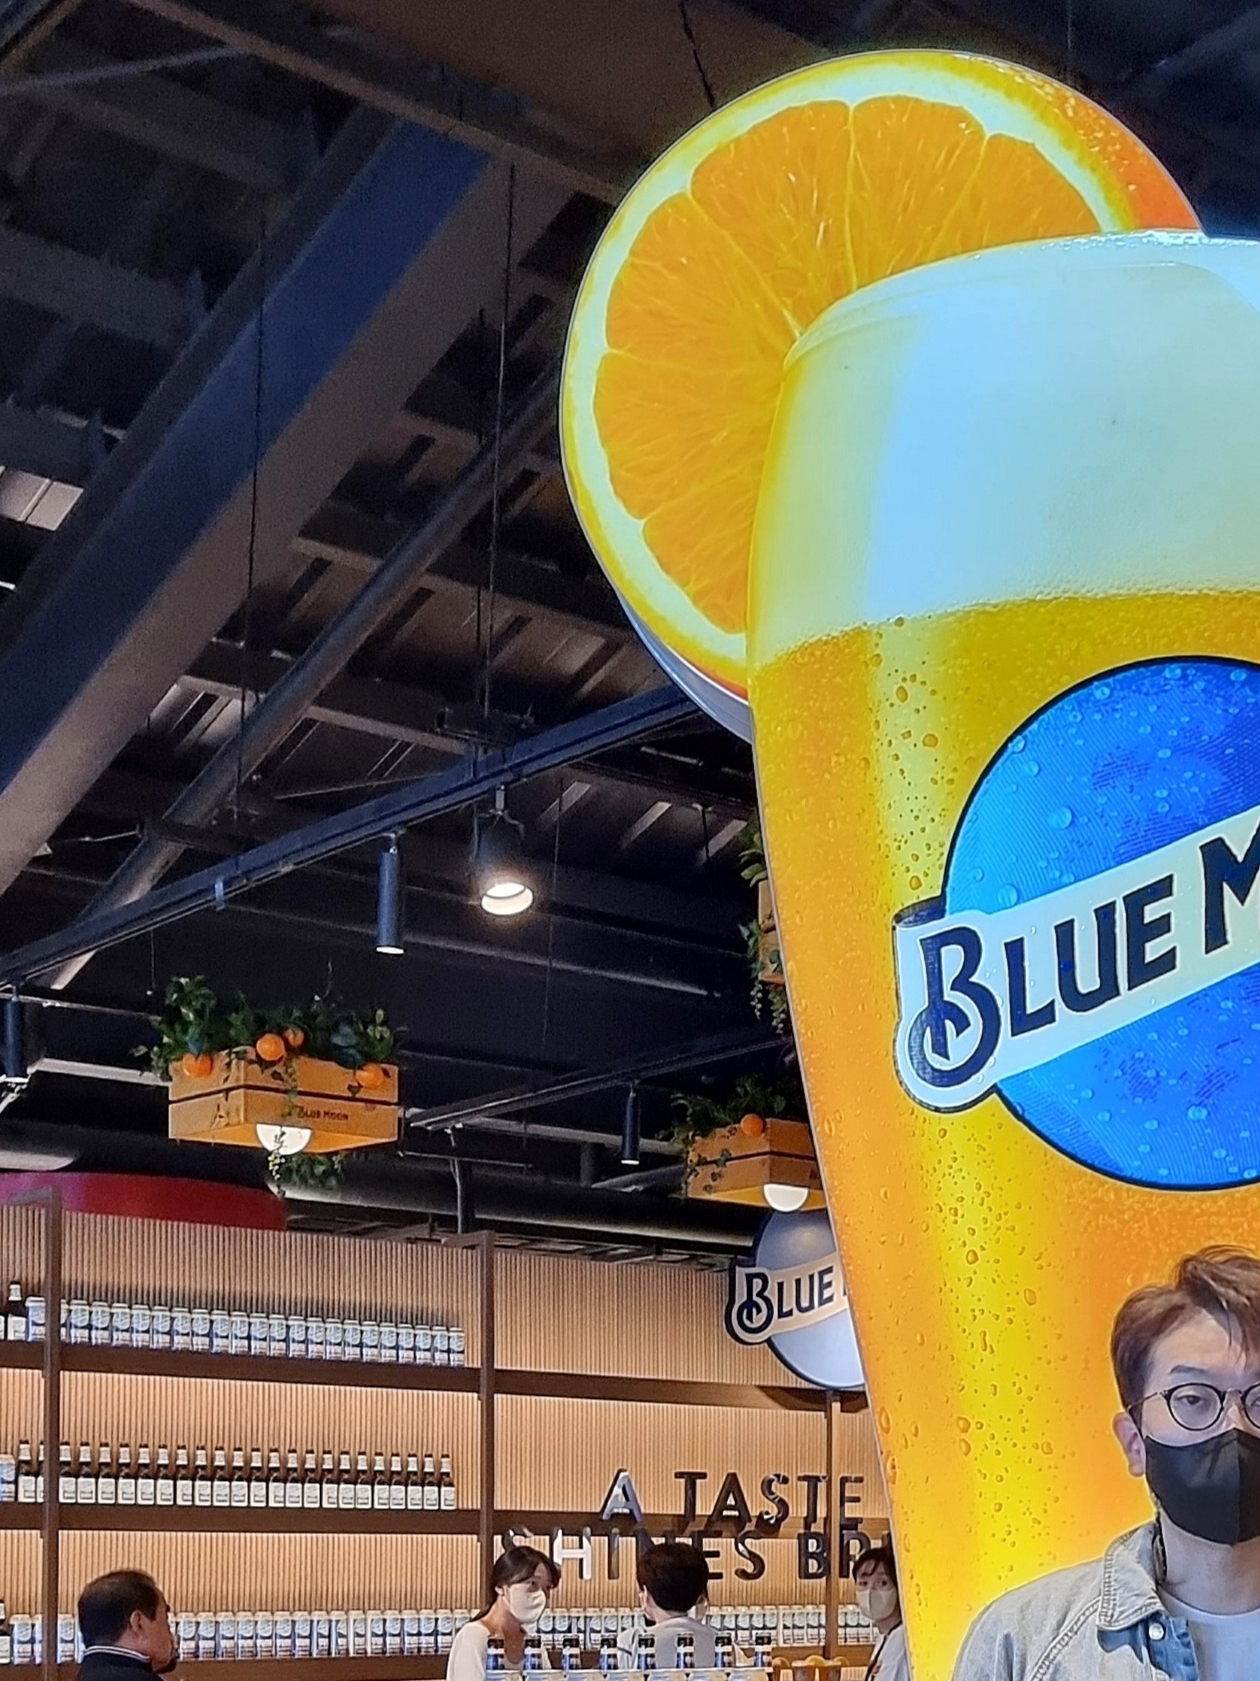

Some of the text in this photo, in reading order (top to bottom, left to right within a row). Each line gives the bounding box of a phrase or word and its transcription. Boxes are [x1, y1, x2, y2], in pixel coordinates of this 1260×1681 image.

[908, 874, 1177, 1088] BLUE
[736, 1266, 834, 1335] BLUE
[601, 1468, 865, 1525] A TASTE
[797, 1530, 889, 1579] BR
